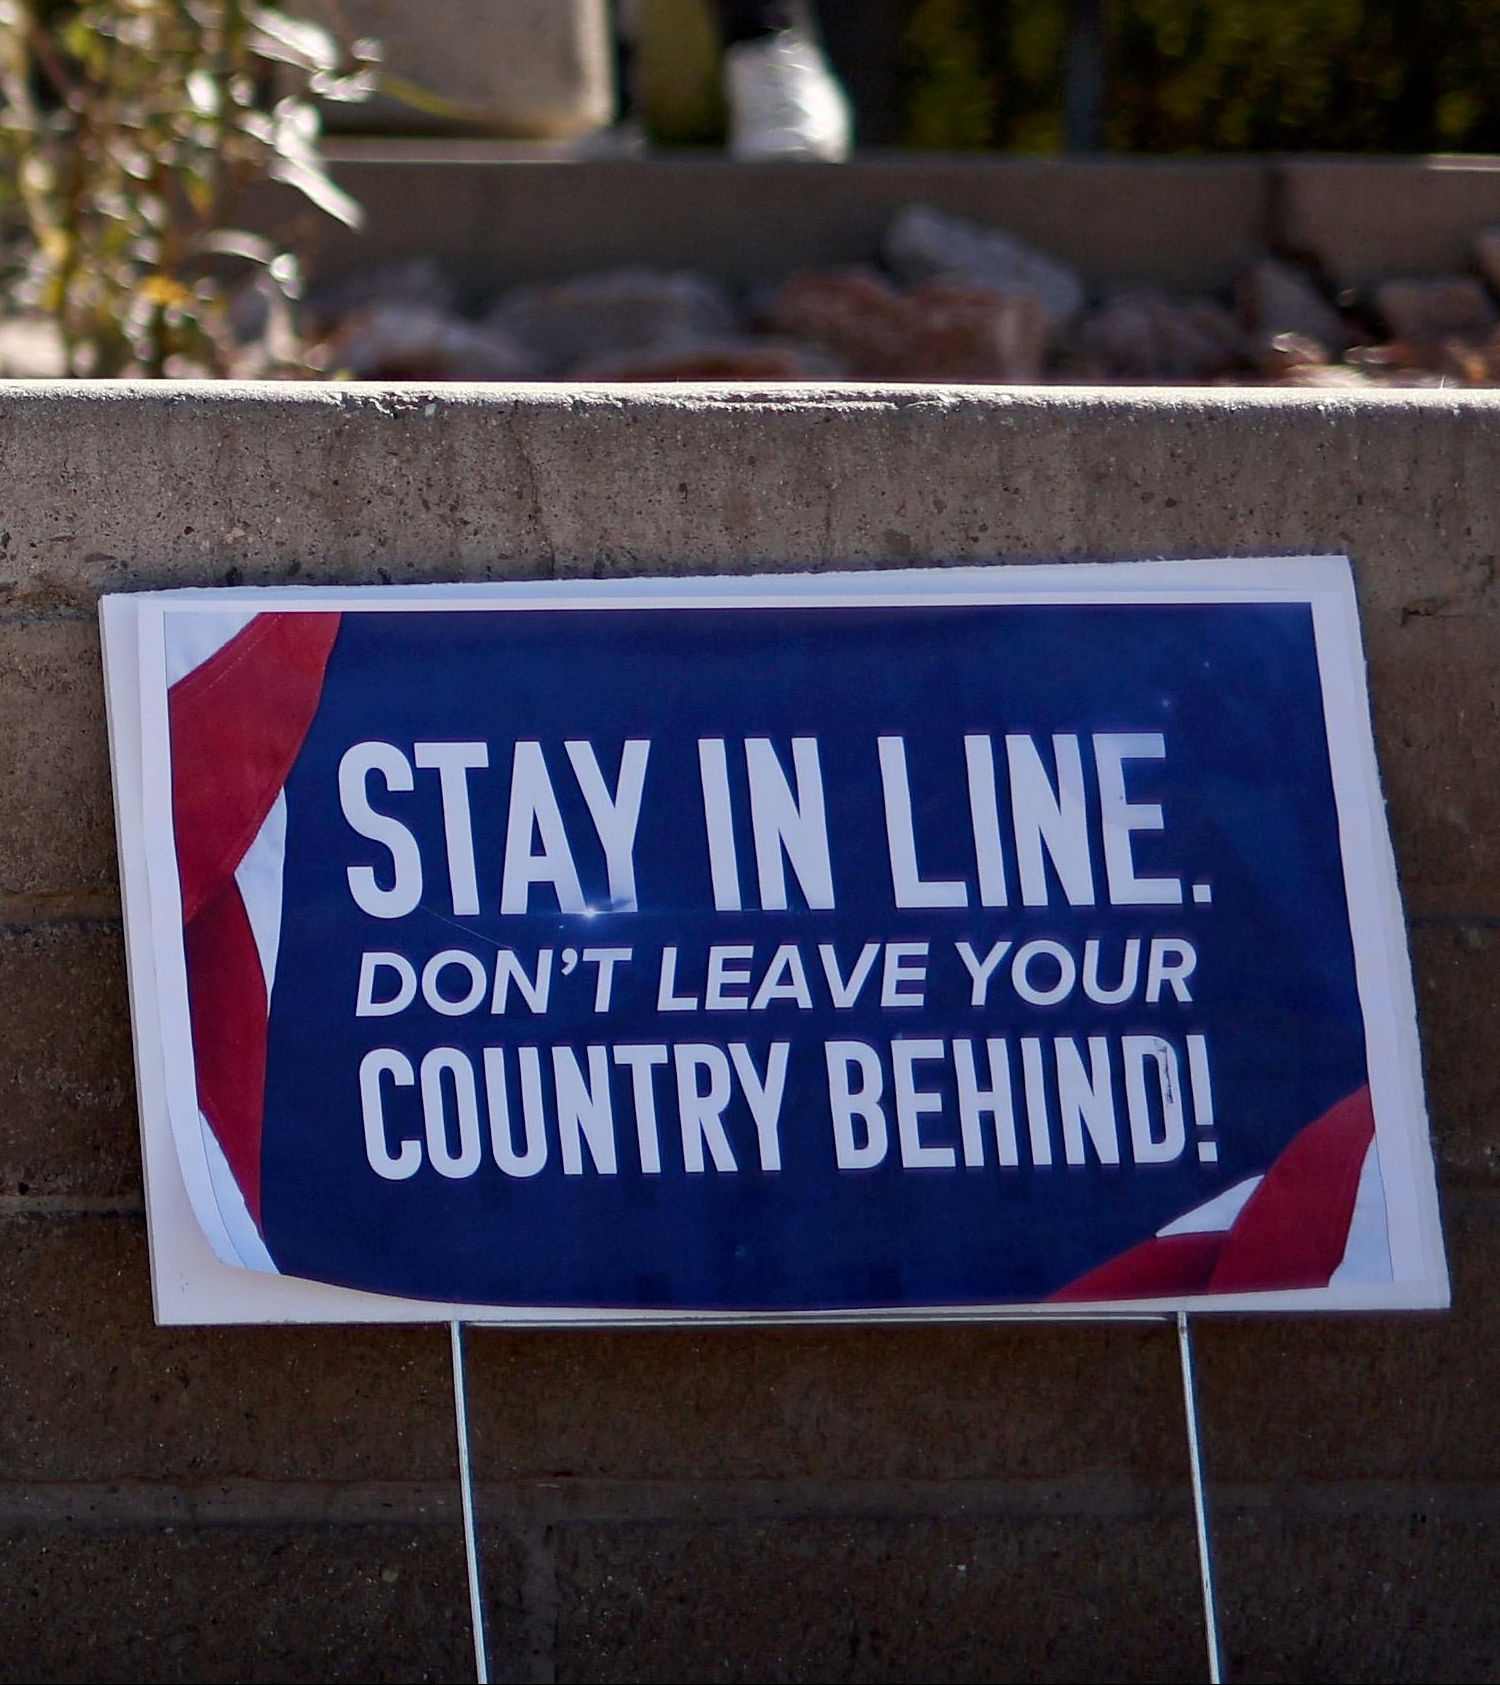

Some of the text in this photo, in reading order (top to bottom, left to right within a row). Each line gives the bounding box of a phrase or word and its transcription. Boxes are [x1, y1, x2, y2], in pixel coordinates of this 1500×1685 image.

[338, 733, 1214, 919] STAY IN LINE.
[355, 938, 1198, 1017] DON’T LEAVE YOUR
[358, 1034, 1219, 1180] COUNTRY BEHIND!
